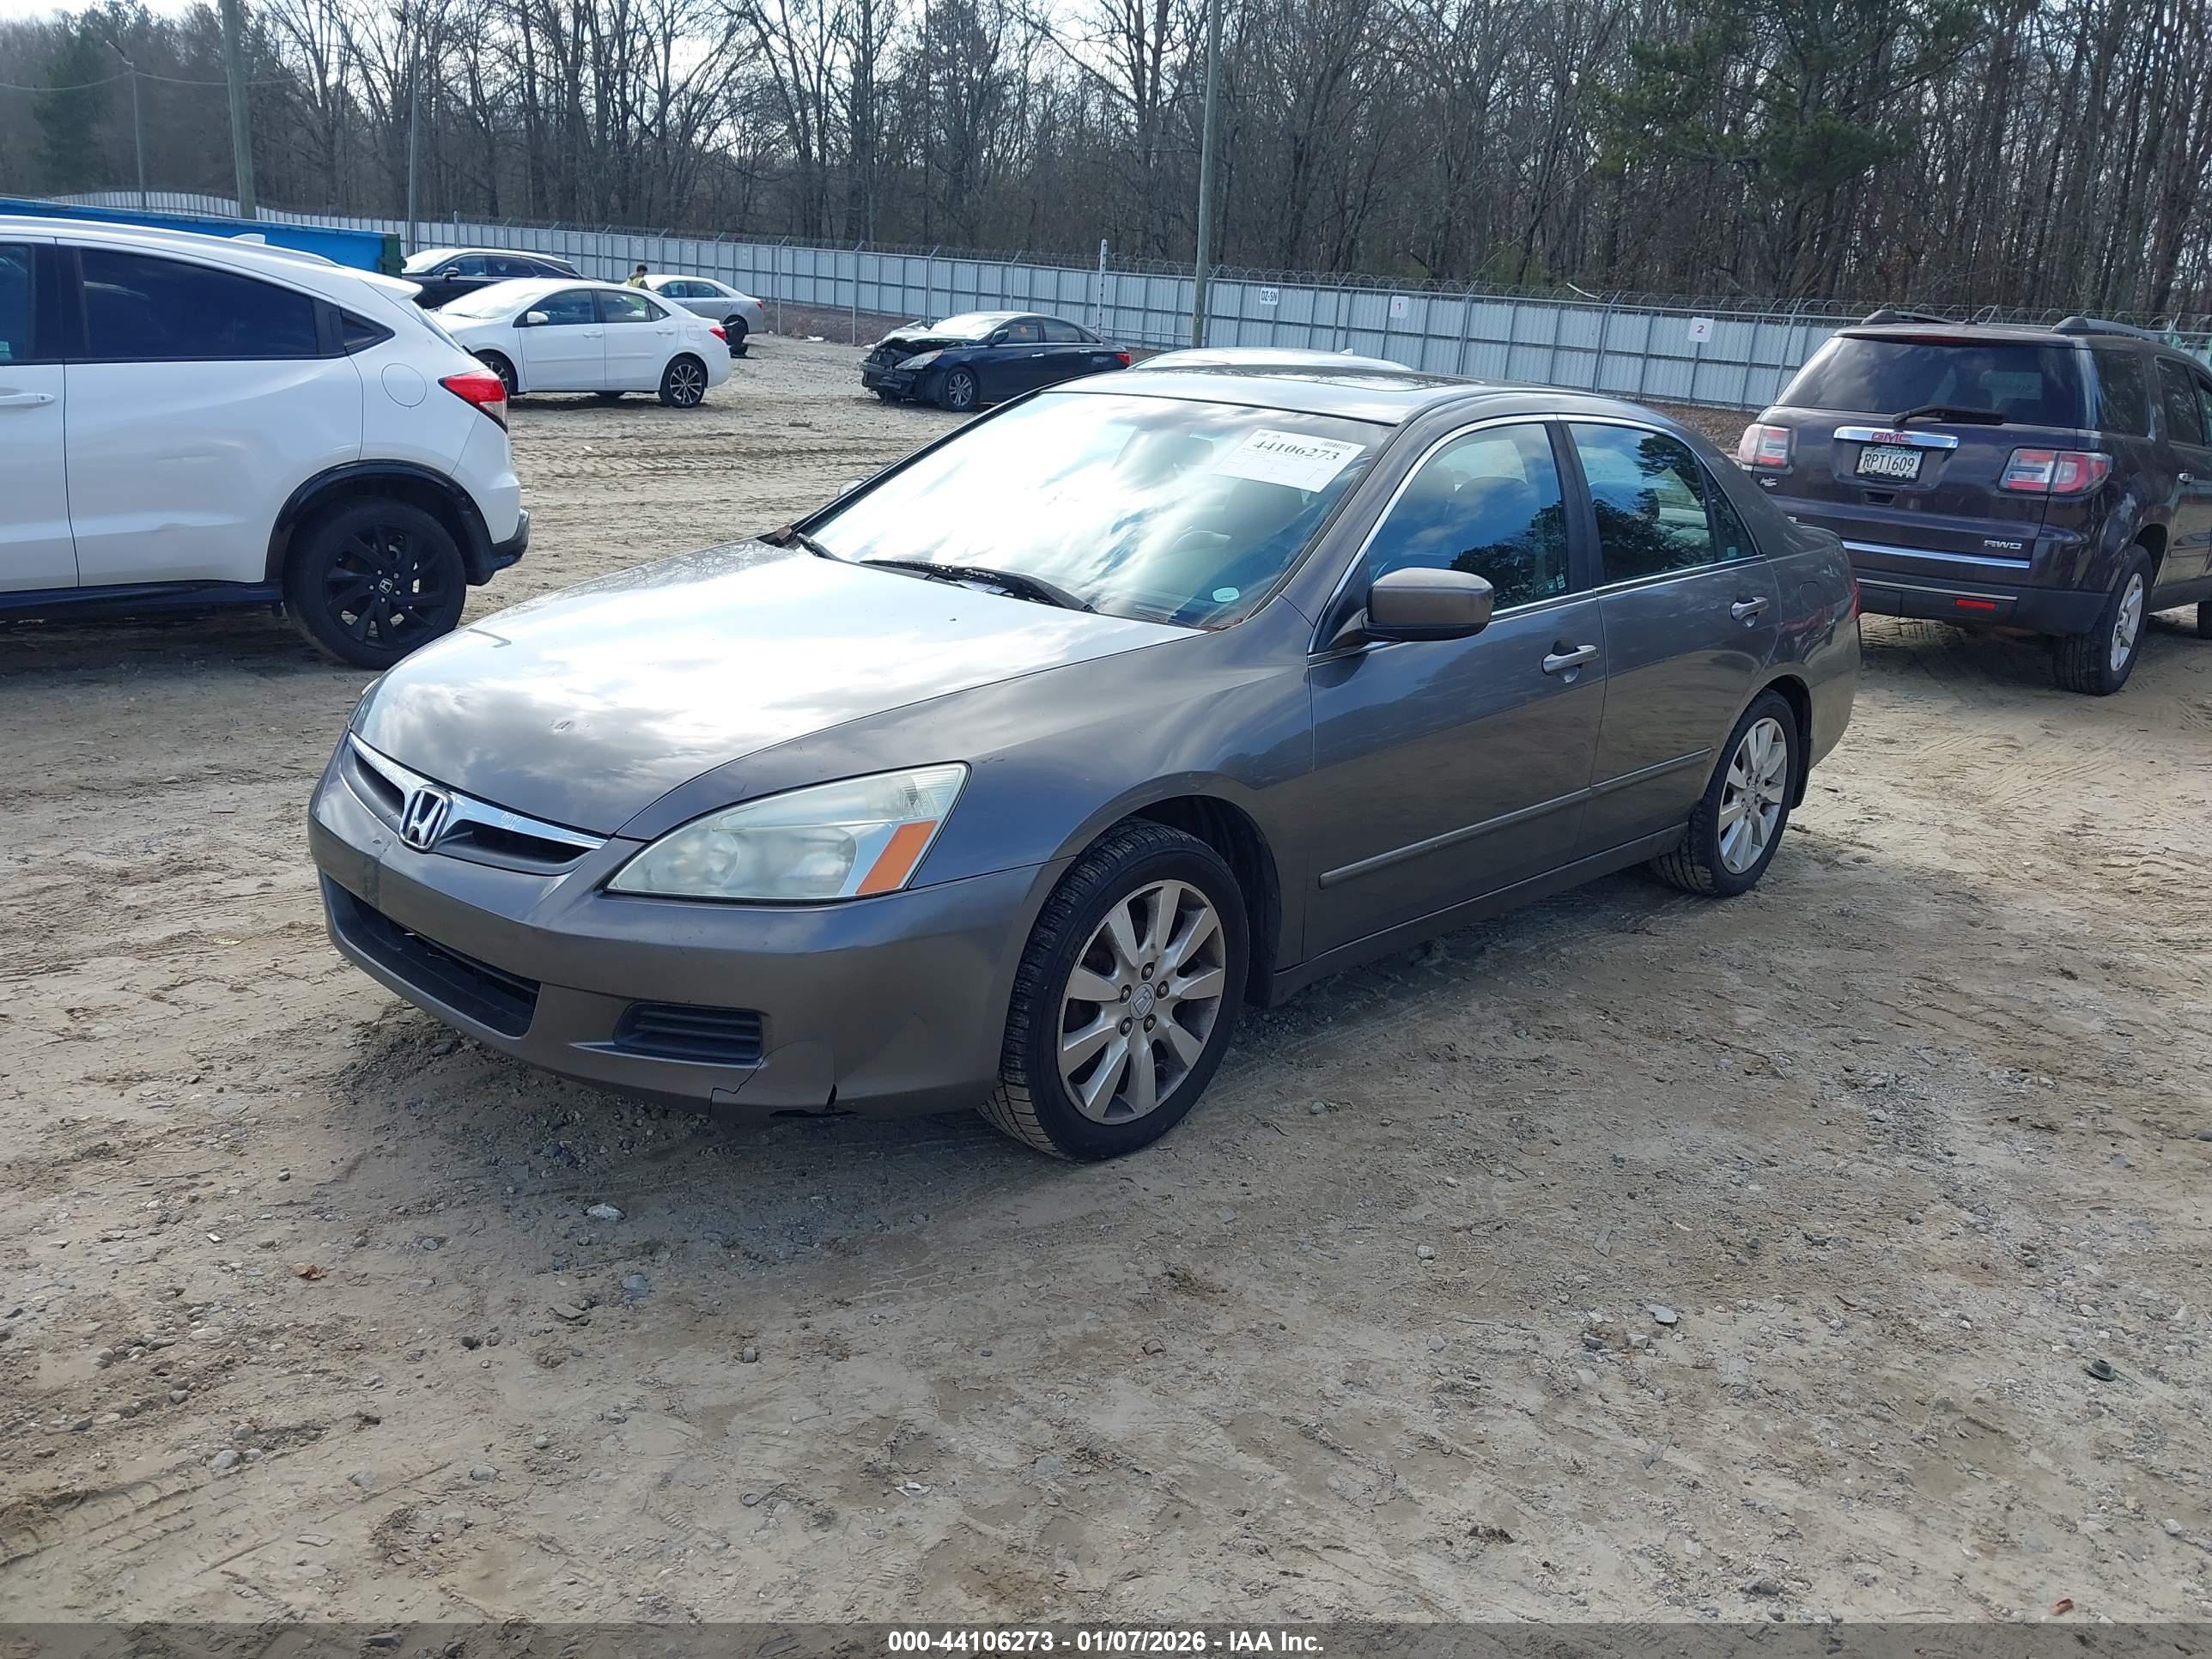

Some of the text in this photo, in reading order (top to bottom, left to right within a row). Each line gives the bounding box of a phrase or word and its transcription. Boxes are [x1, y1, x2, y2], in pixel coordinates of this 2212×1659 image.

[1696, 325, 1705, 334] 2
[1870, 431, 1913, 444] GMC
[1253, 441, 1340, 461] 44106273
[1863, 453, 1916, 473] RPT1609
[1984, 539, 2022, 550] AWD
